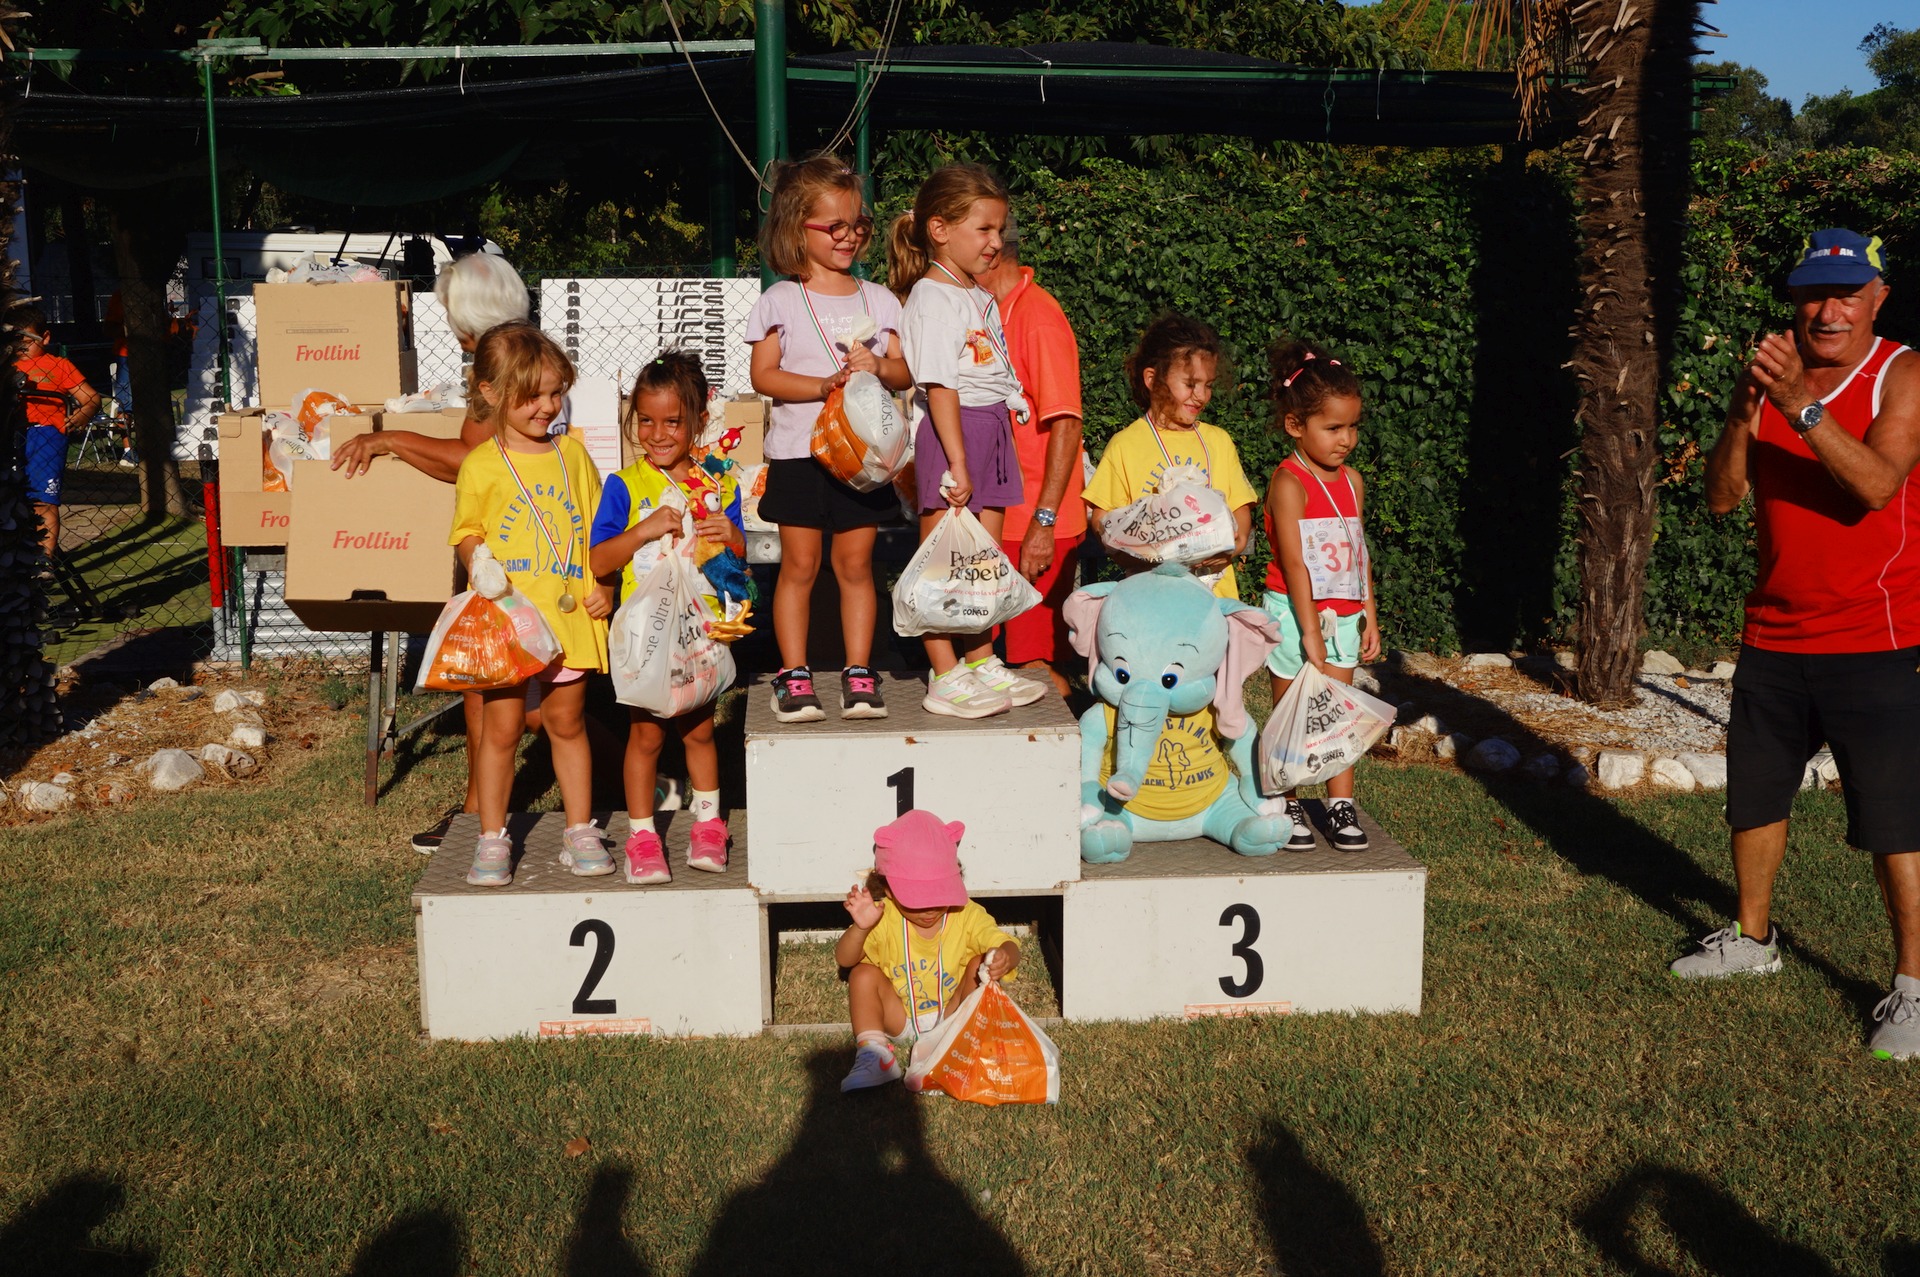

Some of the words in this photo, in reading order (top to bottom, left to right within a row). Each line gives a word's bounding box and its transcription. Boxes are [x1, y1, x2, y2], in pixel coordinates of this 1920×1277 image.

[295, 344, 361, 362] Frollini
[332, 530, 410, 550] Frollini
[506, 558, 531, 572] SACMI
[962, 608, 989, 616] CONAD
[887, 767, 915, 819] 1
[1218, 903, 1264, 998] 3
[569, 918, 617, 1014] 2
